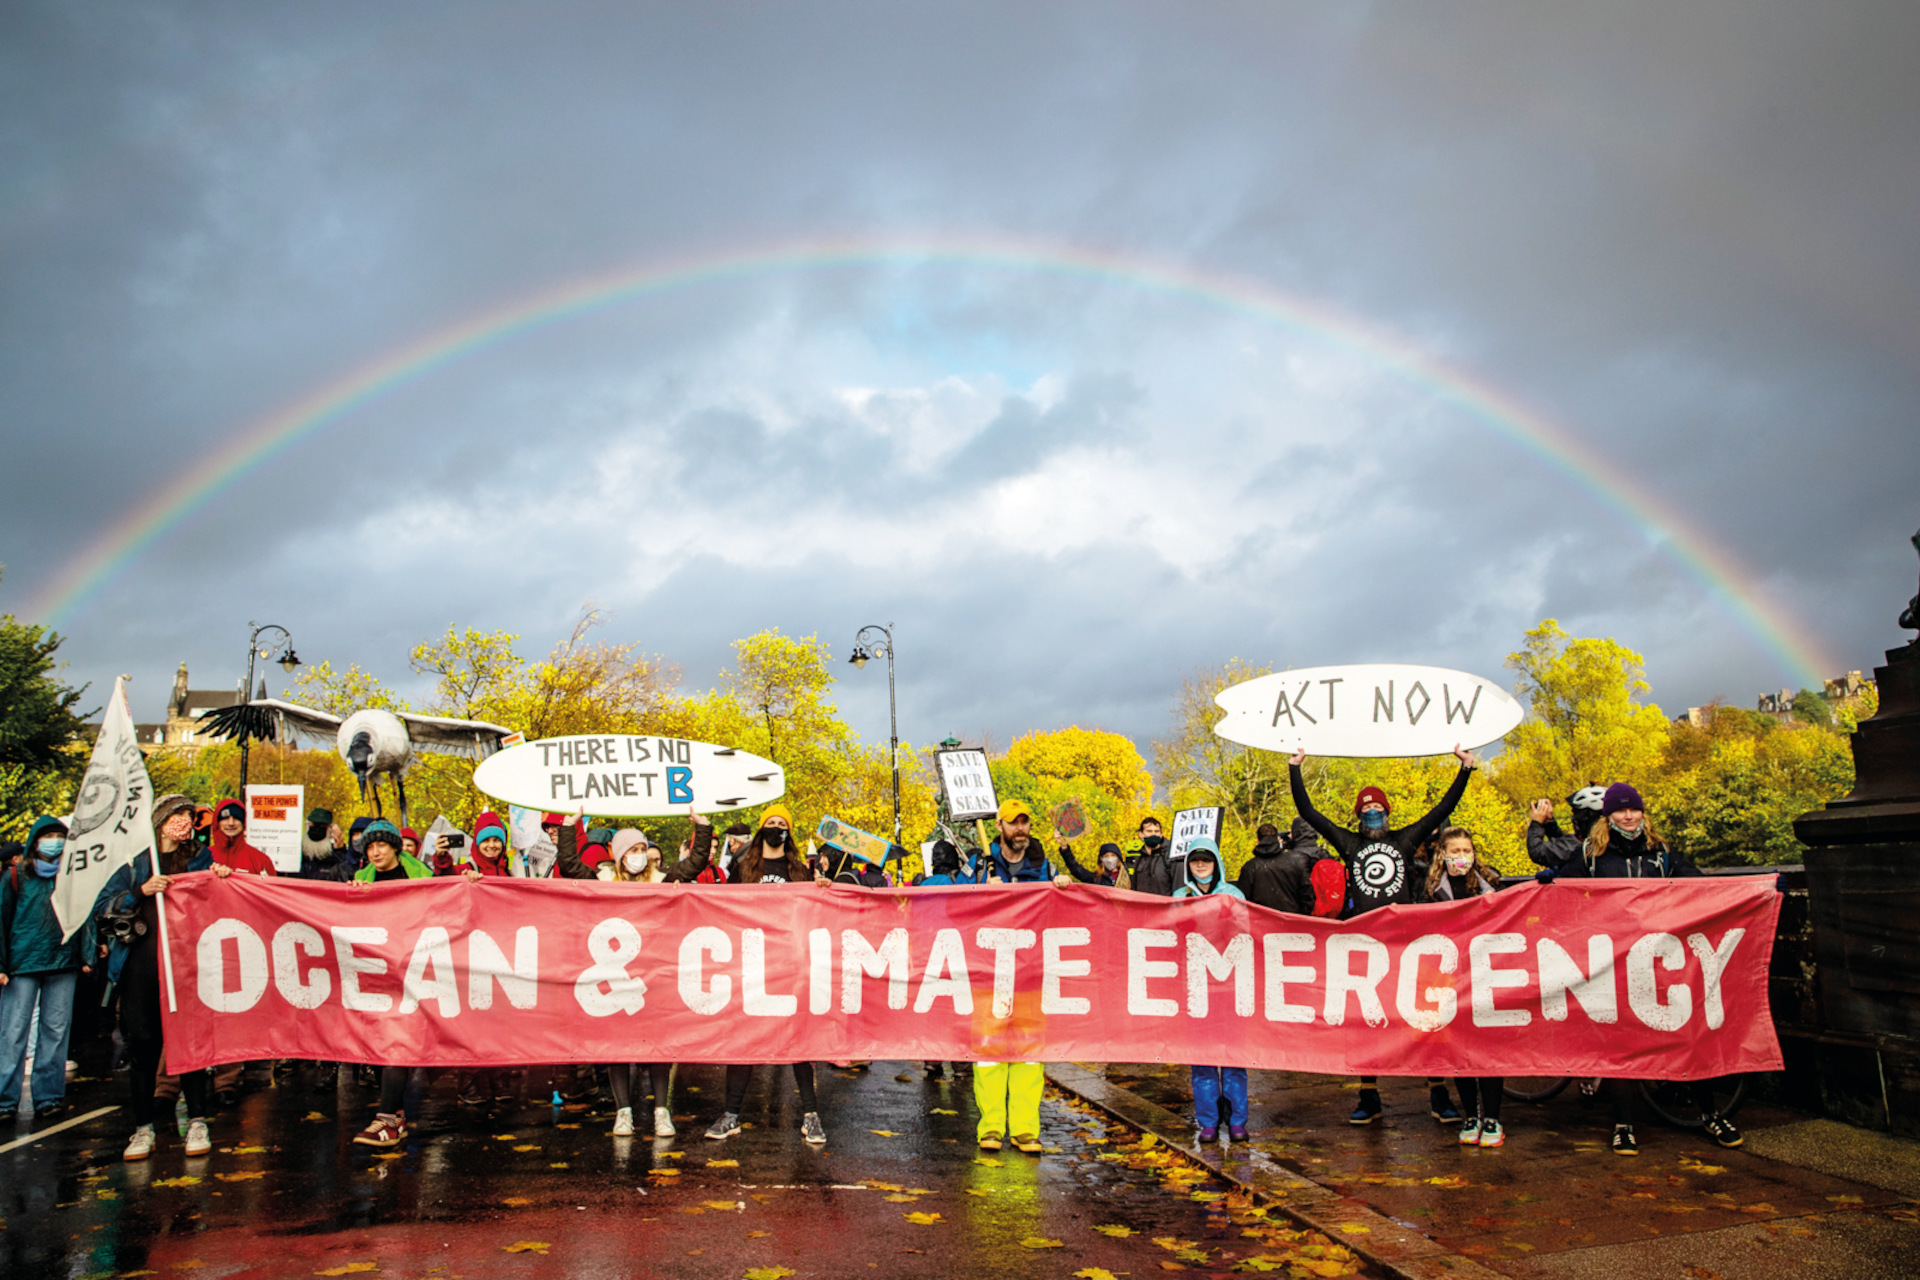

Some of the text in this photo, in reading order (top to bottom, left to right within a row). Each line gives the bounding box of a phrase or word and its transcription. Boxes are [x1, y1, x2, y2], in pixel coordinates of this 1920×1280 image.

[1272, 678, 1483, 727] ACT NOW
[535, 737, 691, 766] THERE IS NO
[945, 752, 982, 768] SAVE
[550, 766, 694, 804] PLANET B
[953, 773, 984, 789] OUR
[251, 796, 298, 806] USE THE POWER
[955, 795, 991, 811] SEAS
[254, 809, 286, 819] OF NATURE
[1180, 808, 1215, 822] SAVE
[1180, 823, 1209, 837] OUR
[1353, 861, 1381, 898] AGAINST
[1384, 859, 1405, 897] SEWAGE
[196, 917, 1747, 1031] OCEAN & CLIMATE EMERGENCY
